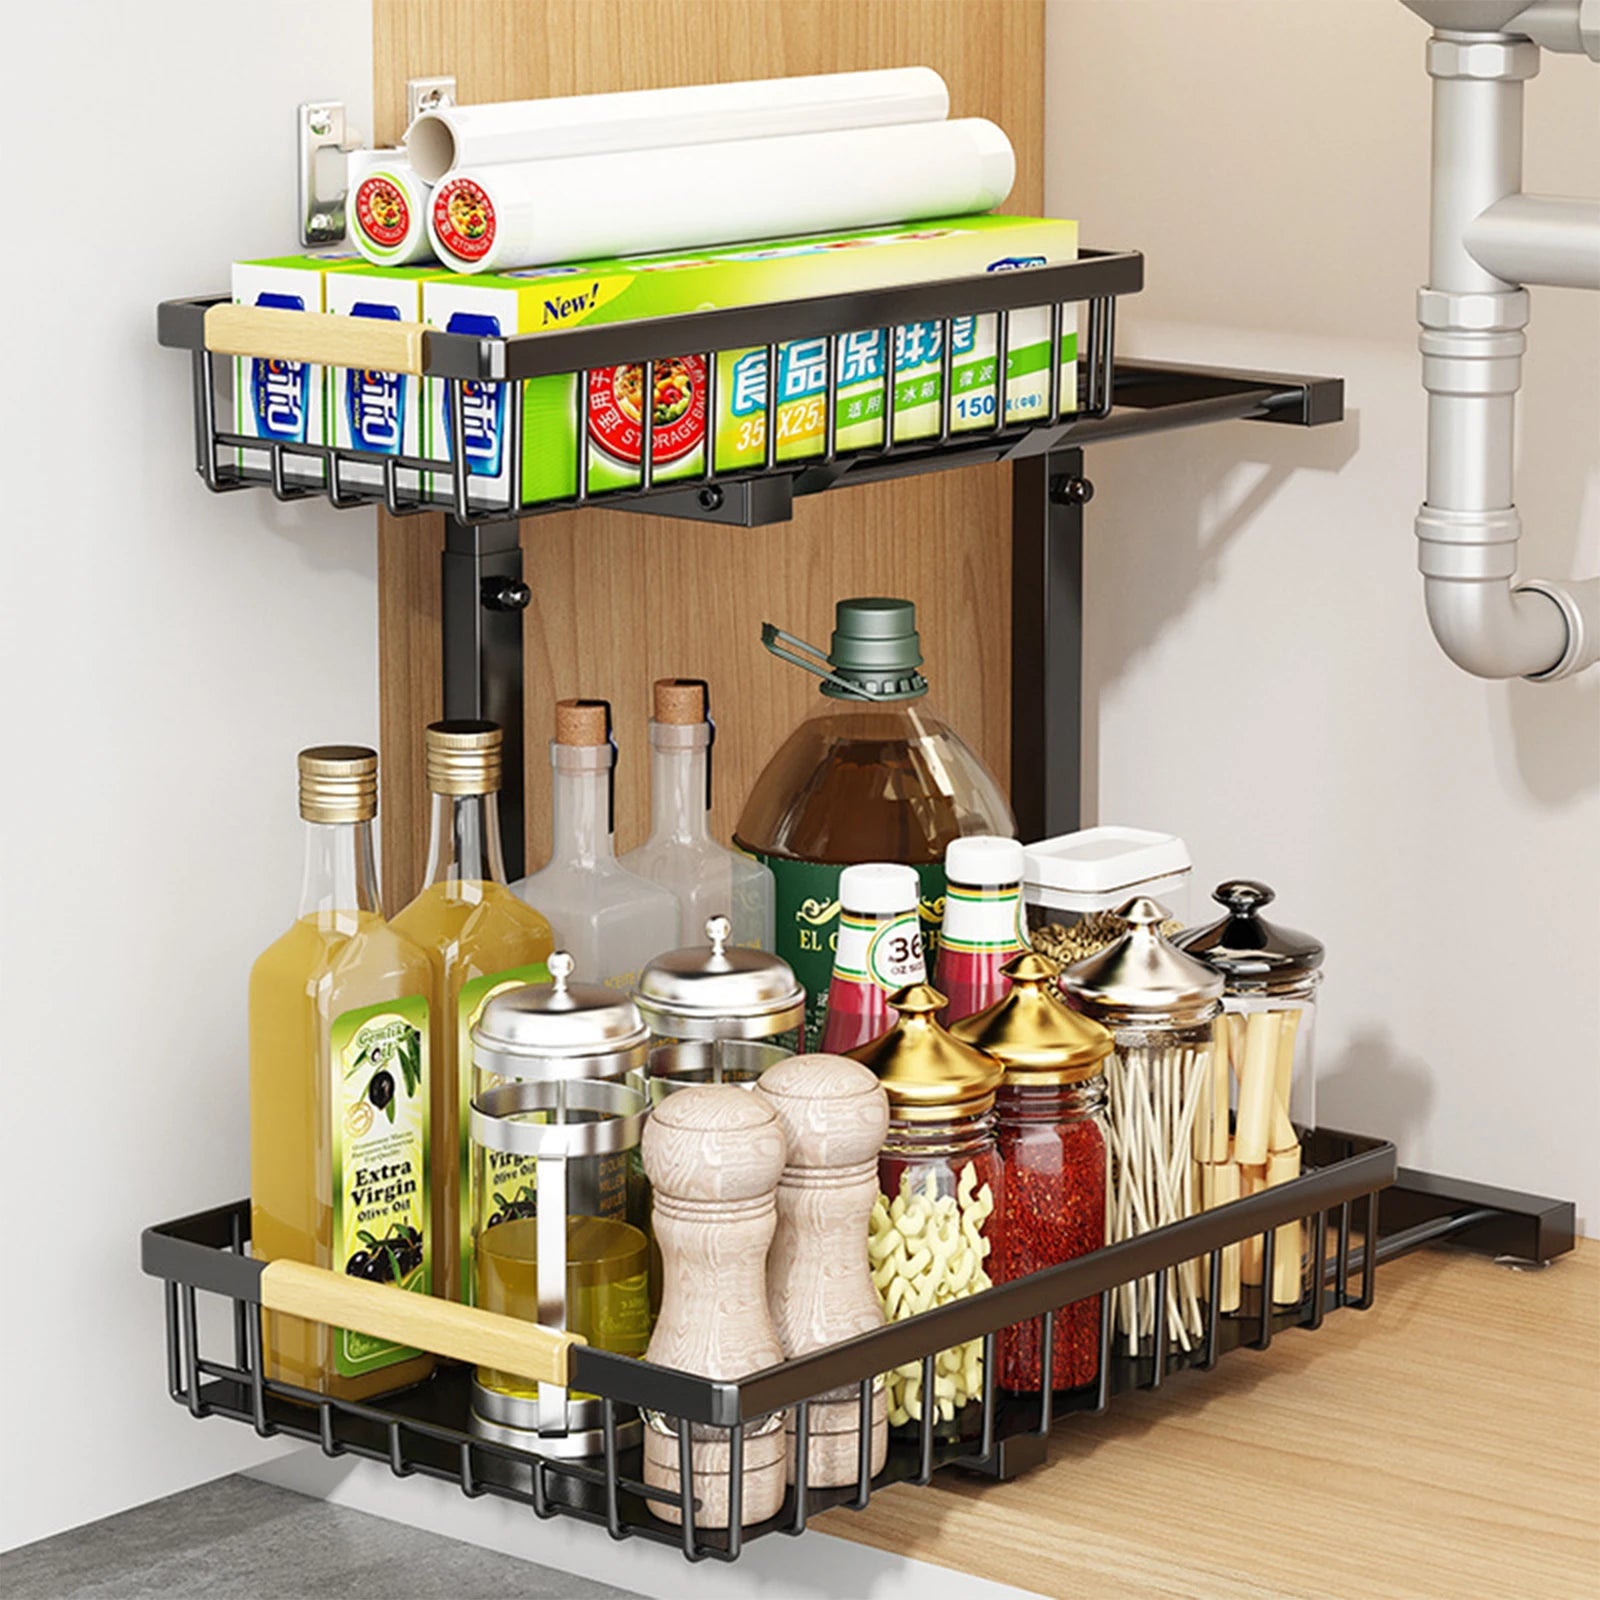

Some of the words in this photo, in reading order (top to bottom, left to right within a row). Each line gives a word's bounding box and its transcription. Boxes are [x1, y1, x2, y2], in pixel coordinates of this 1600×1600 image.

[542, 282, 599, 326] New!
[800, 929, 822, 950] EL
[888, 934, 921, 963] 36
[489, 1152, 536, 1170] Virg
[355, 1161, 411, 1187] Extra
[493, 1171, 518, 1185] Olive
[351, 1179, 416, 1207] Virgin
[357, 1207, 389, 1222] Olive
[392, 1198, 410, 1213] Oil
